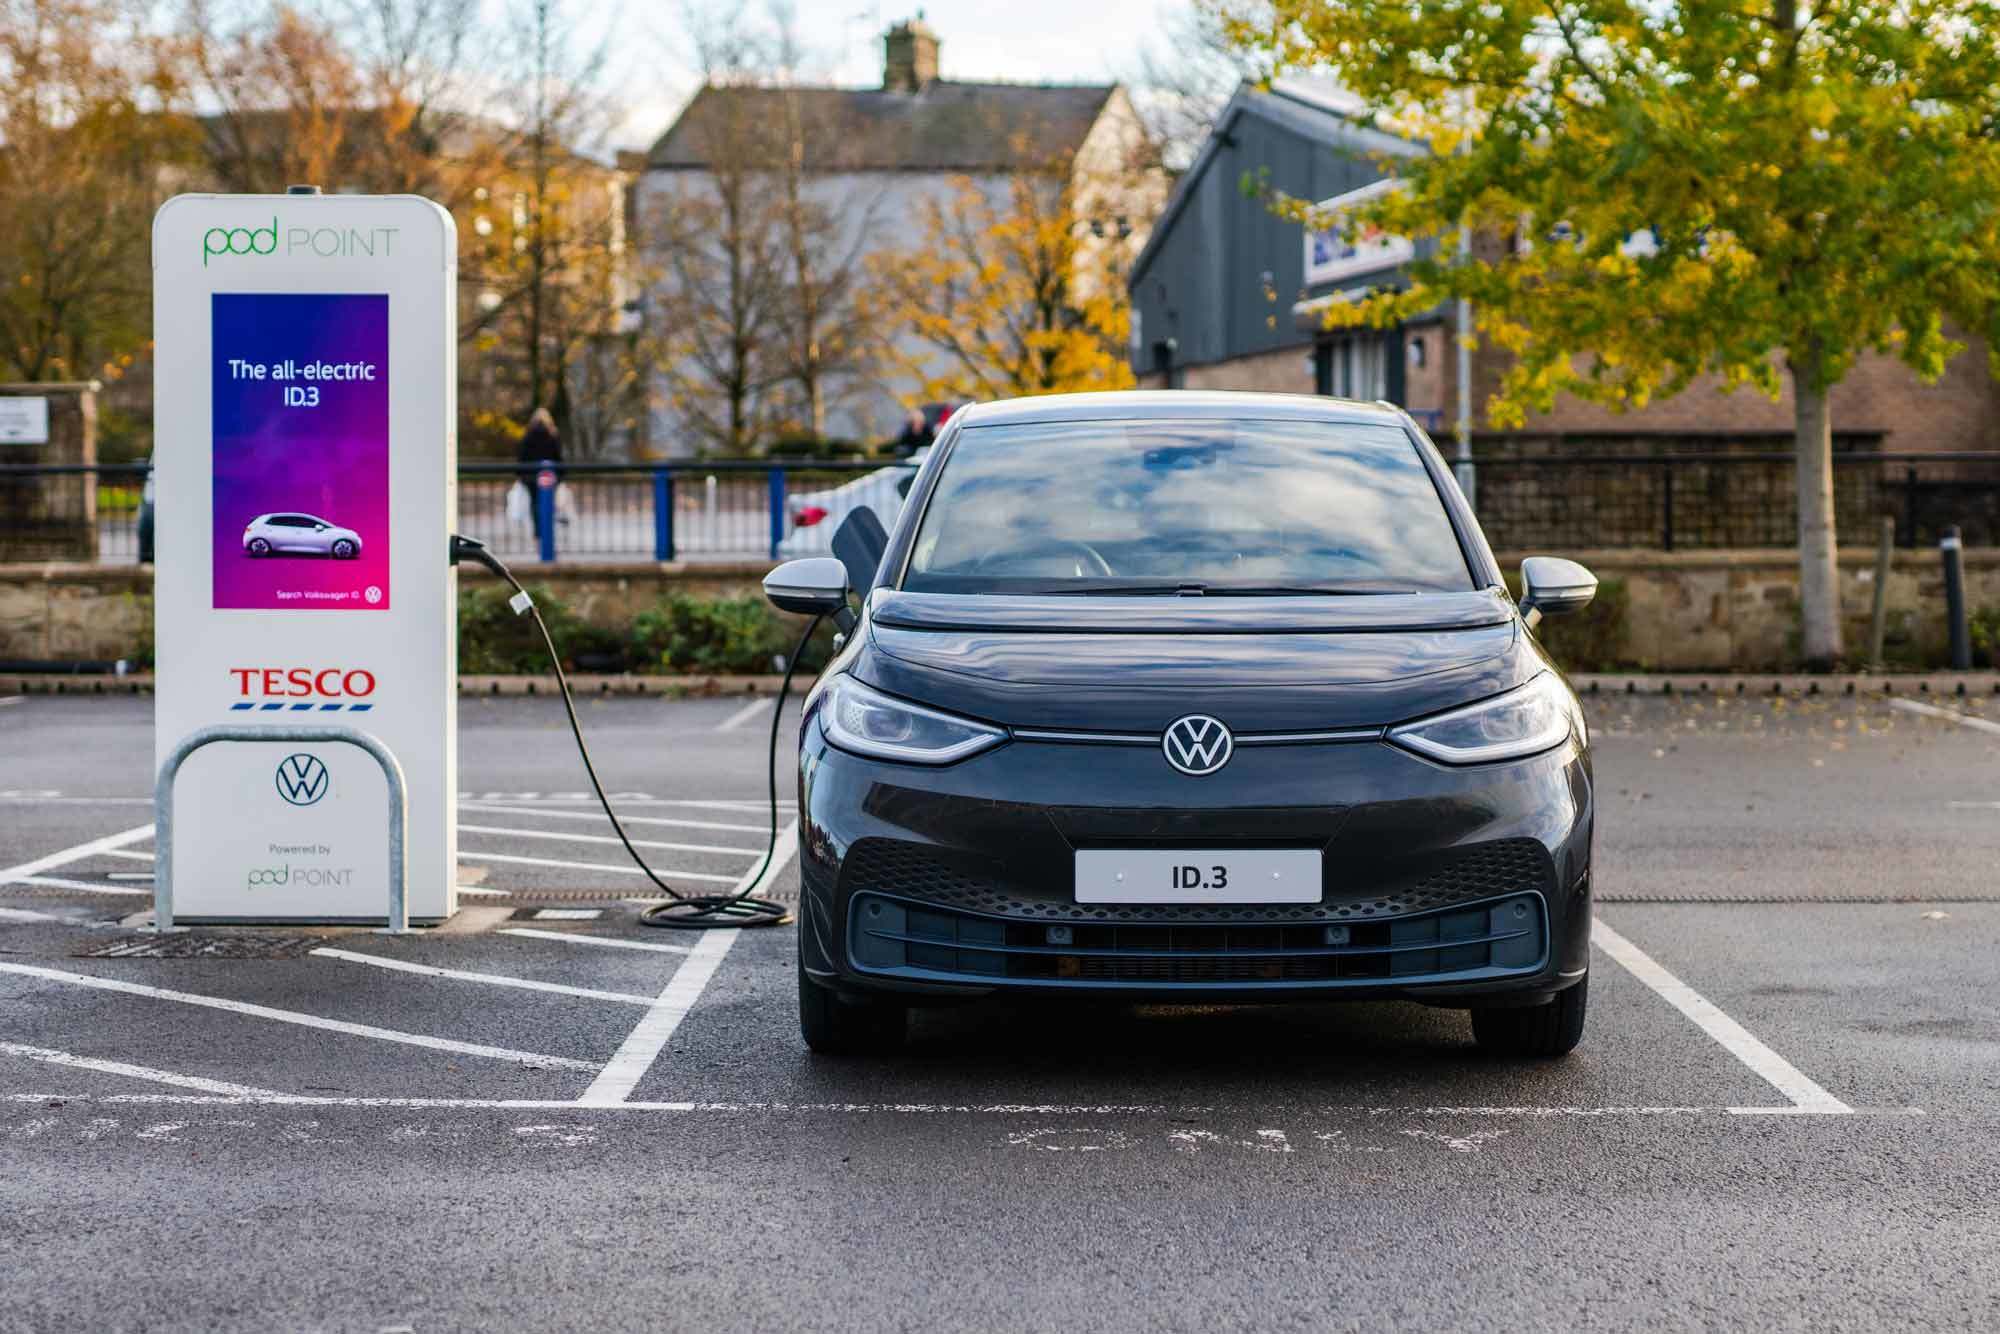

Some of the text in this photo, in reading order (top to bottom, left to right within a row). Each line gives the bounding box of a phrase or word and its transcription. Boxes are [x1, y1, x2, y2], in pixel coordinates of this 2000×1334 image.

[204, 216, 400, 268] pod POINT
[228, 359, 376, 381] The all-electric
[229, 668, 376, 697] TESCO
[268, 843, 331, 857] Powered by
[248, 863, 353, 891] pod POINT
[1172, 865, 1228, 889] ID.3
